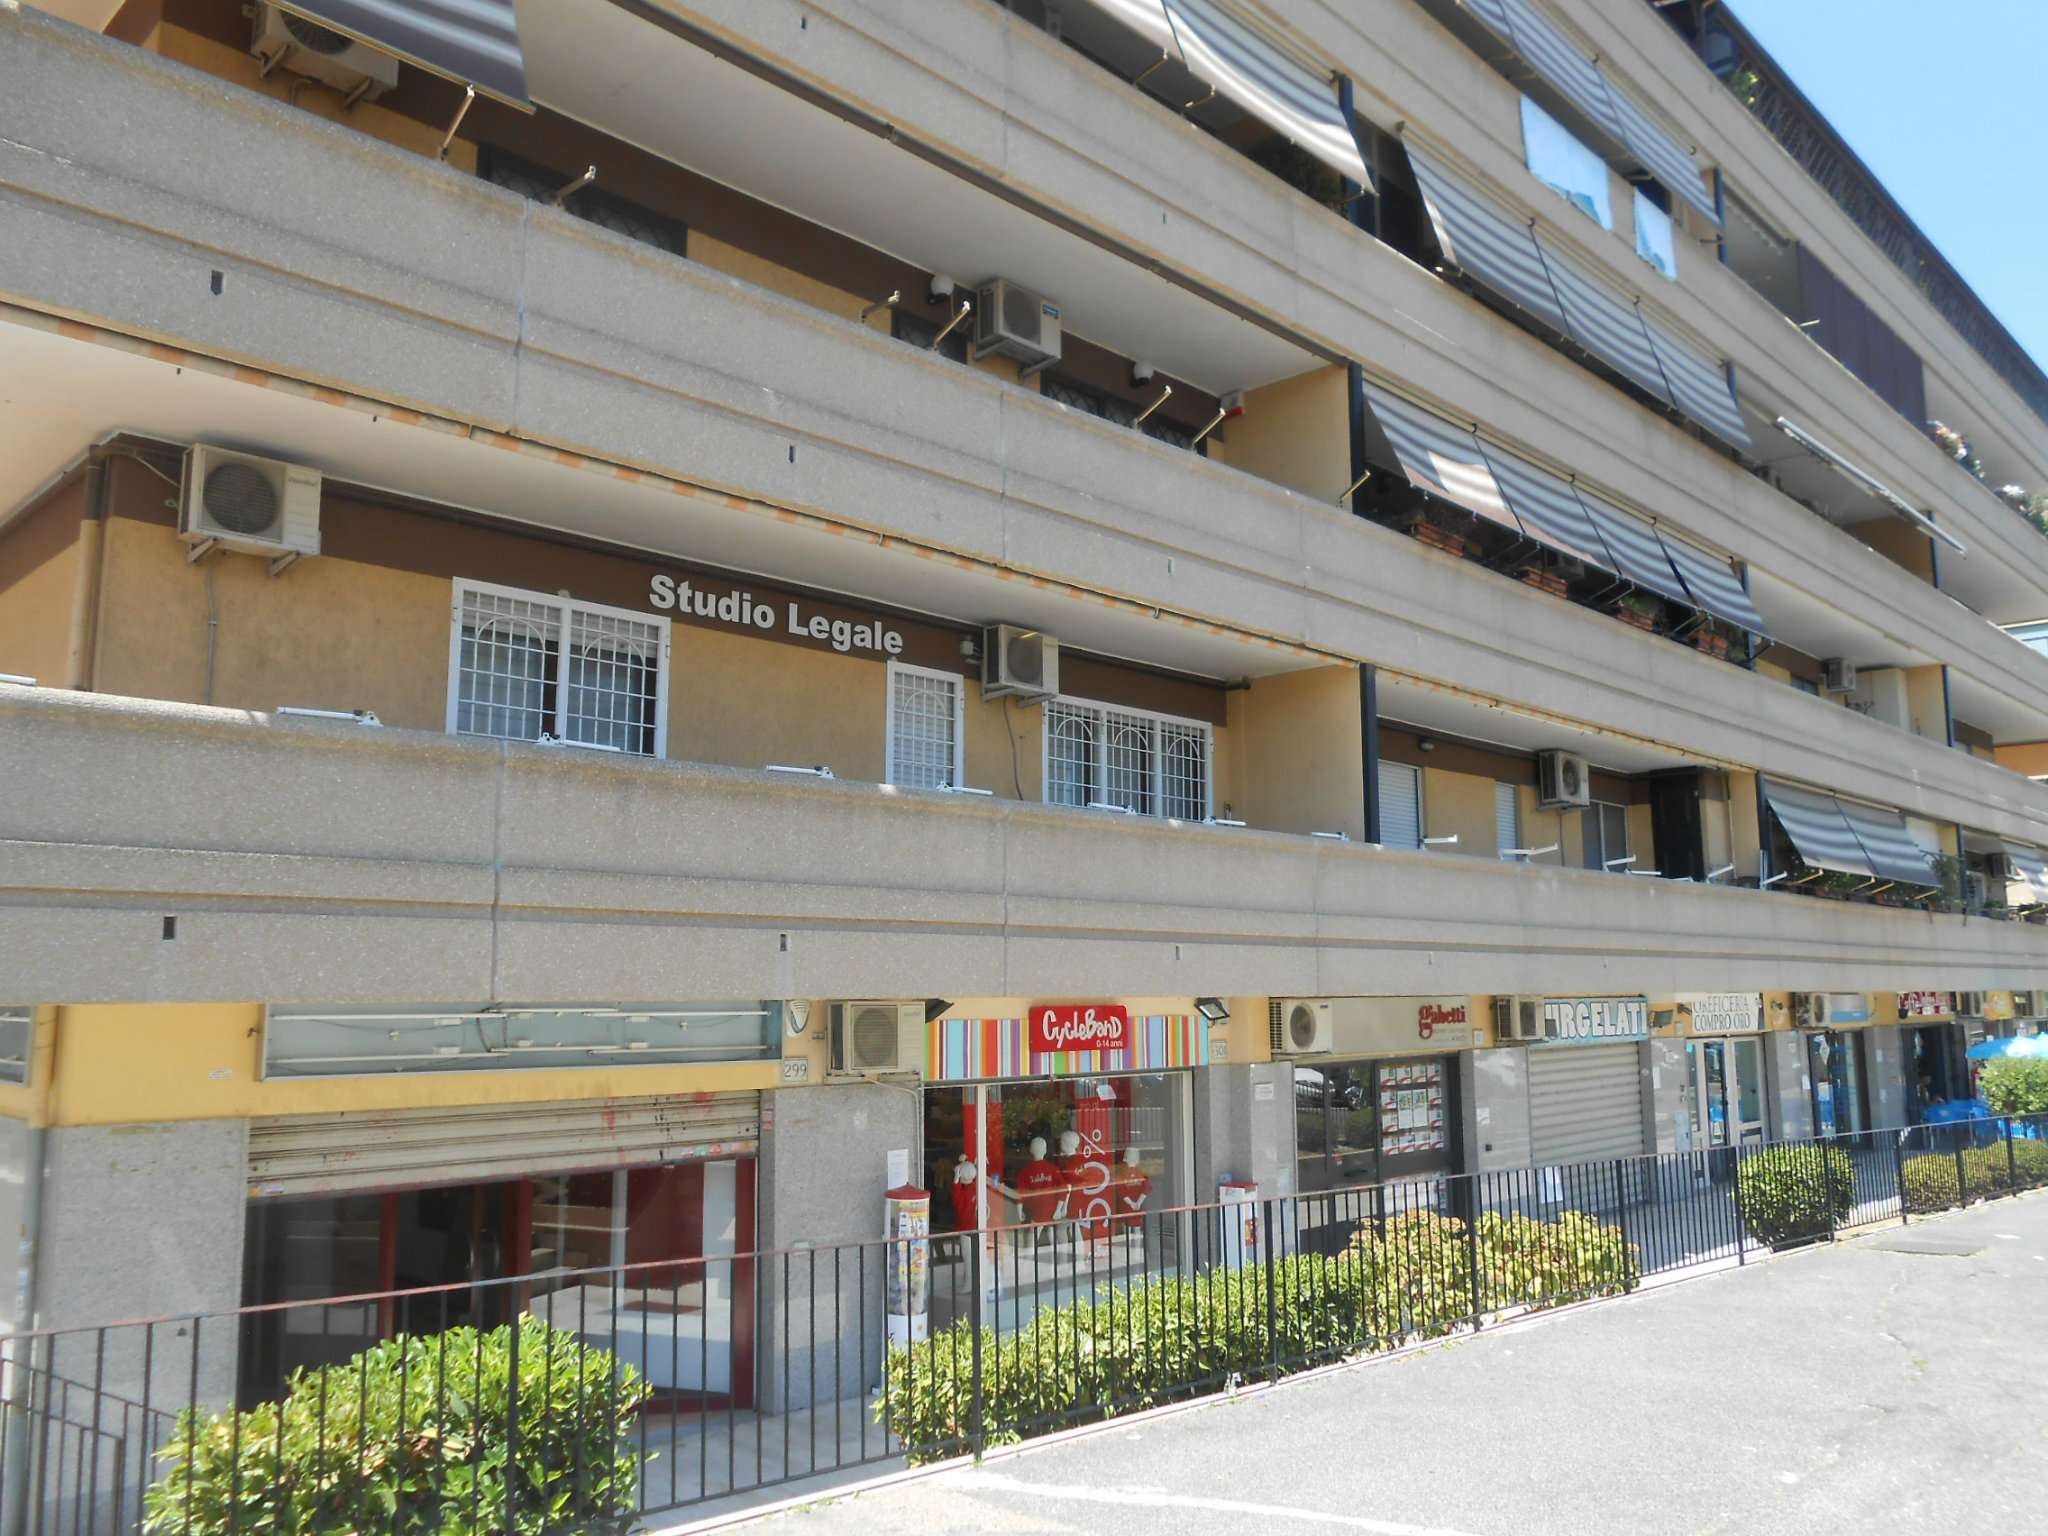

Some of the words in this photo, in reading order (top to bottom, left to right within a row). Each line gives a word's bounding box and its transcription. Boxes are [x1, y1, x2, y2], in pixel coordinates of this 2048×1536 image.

[650, 574, 775, 629] Studio
[788, 602, 904, 654] Legale
[1419, 1003, 1467, 1040] gabetti
[1544, 1001, 1648, 1039] URGELATI
[1694, 1013, 1731, 1032] COMPRO
[1733, 1012, 1751, 1029] ORO
[1096, 1040, 1109, 1048] 0-14
[1110, 1039, 1123, 1048] anni
[784, 1063, 807, 1078] 299
